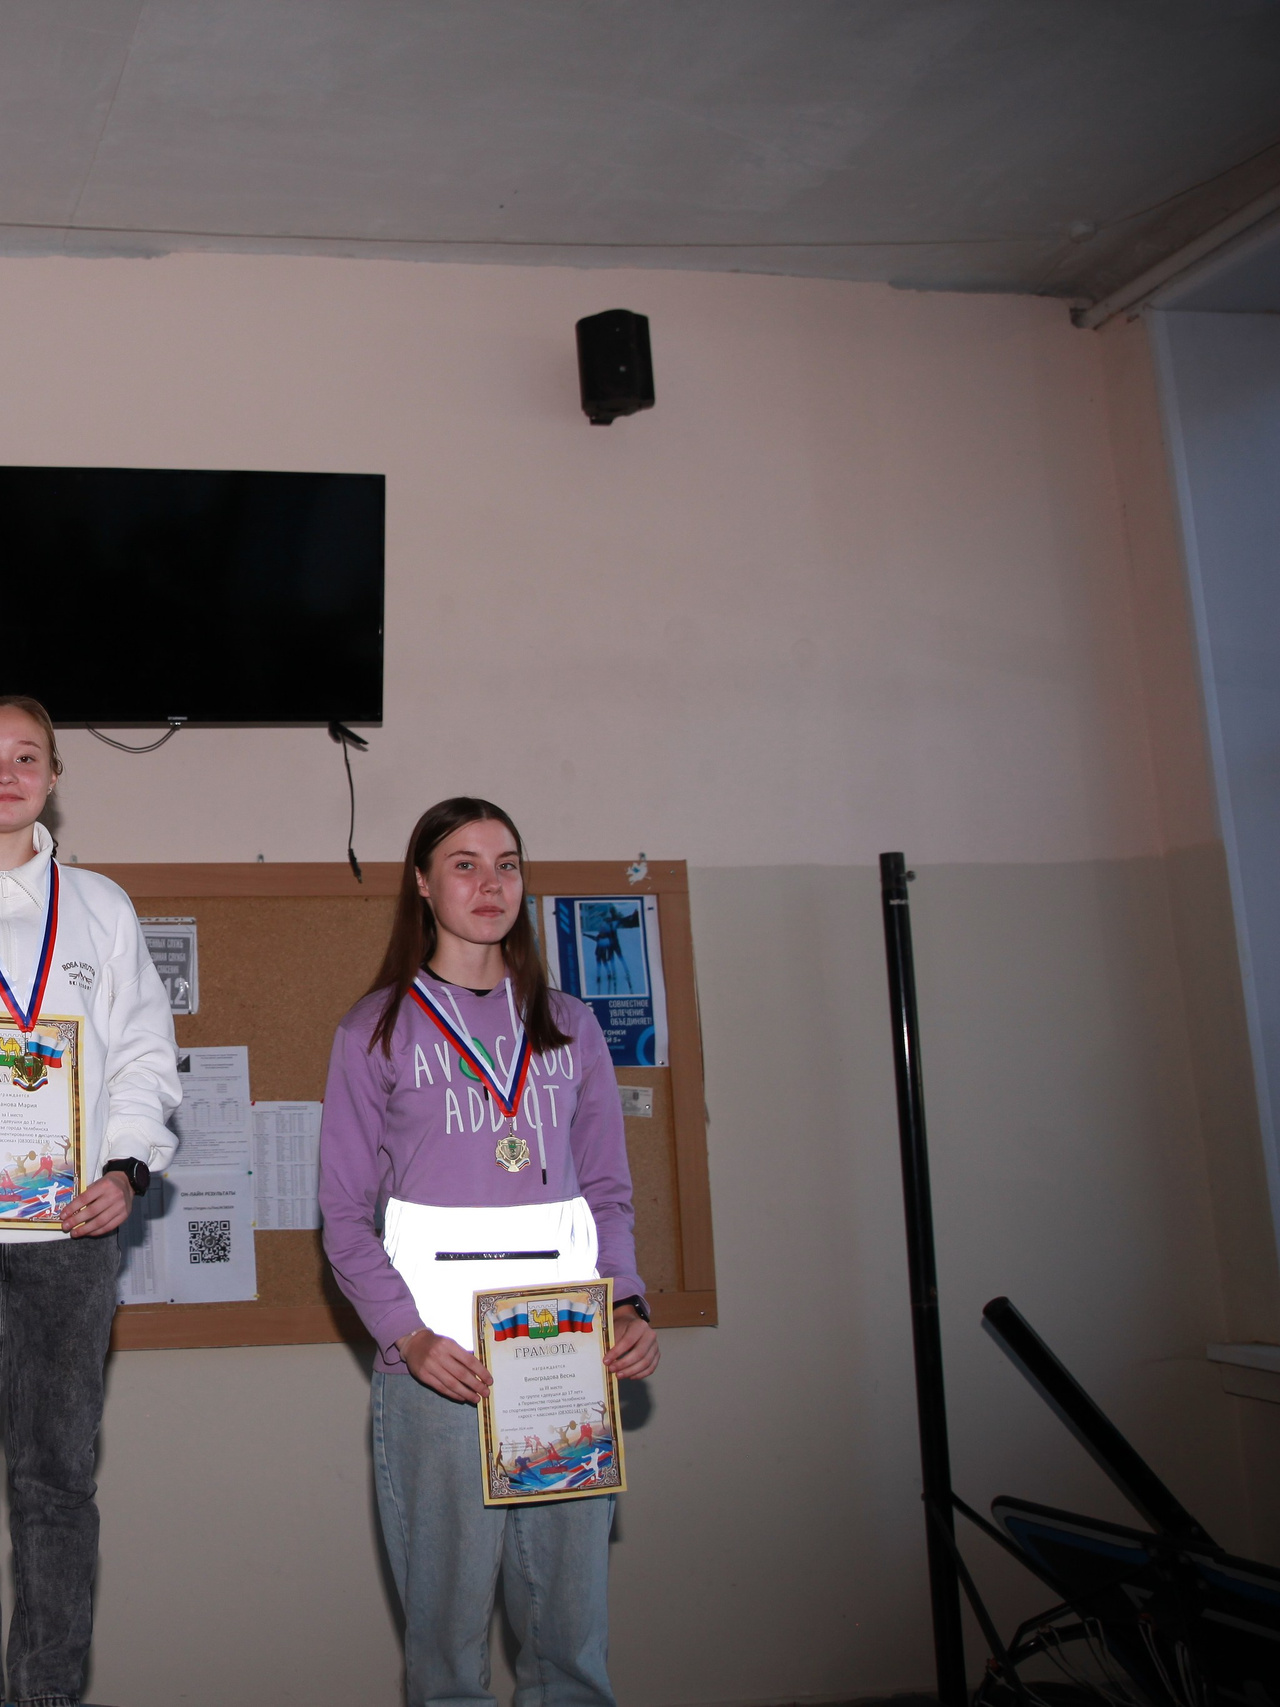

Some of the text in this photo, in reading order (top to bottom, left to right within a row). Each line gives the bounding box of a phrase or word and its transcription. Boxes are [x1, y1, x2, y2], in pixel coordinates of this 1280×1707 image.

[62, 961, 79, 971] ROSA
[157, 965, 179, 974] СПАСЕНИЯ
[608, 999, 649, 1008] СОВМЕСТНОЕ
[609, 1008, 645, 1017] УВЛЕЧЕНИЕ
[610, 1017, 652, 1026] ОБЪЕДИНЯЕТ!
[515, 1343, 576, 1358] ГРАМОТА
